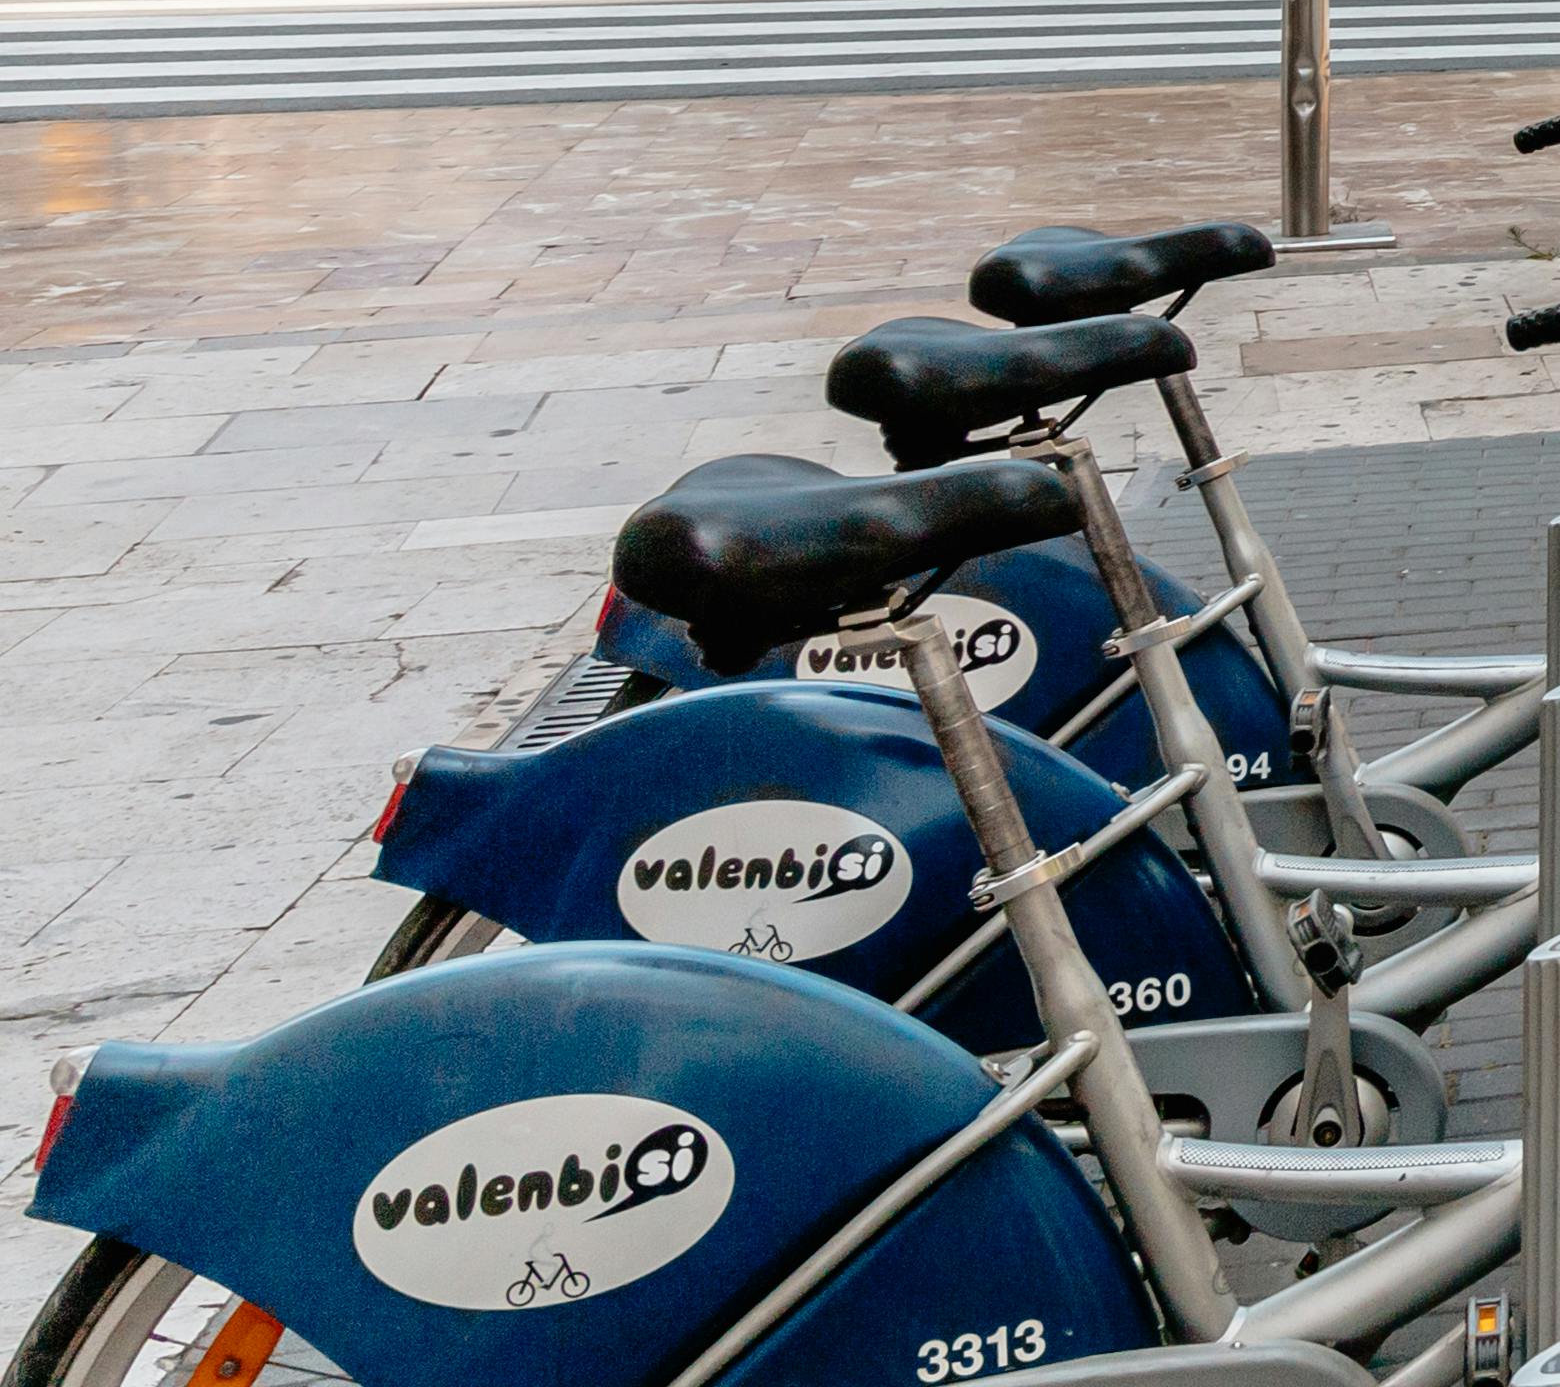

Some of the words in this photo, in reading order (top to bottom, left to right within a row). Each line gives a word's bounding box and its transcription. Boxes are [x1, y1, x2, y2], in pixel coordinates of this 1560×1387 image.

[1229, 751, 1272, 783] 94
[634, 840, 890, 892] valenbisi
[1108, 971, 1193, 1017] 360
[372, 1126, 703, 1231] valenbisi
[915, 1317, 1047, 1385] 3313
